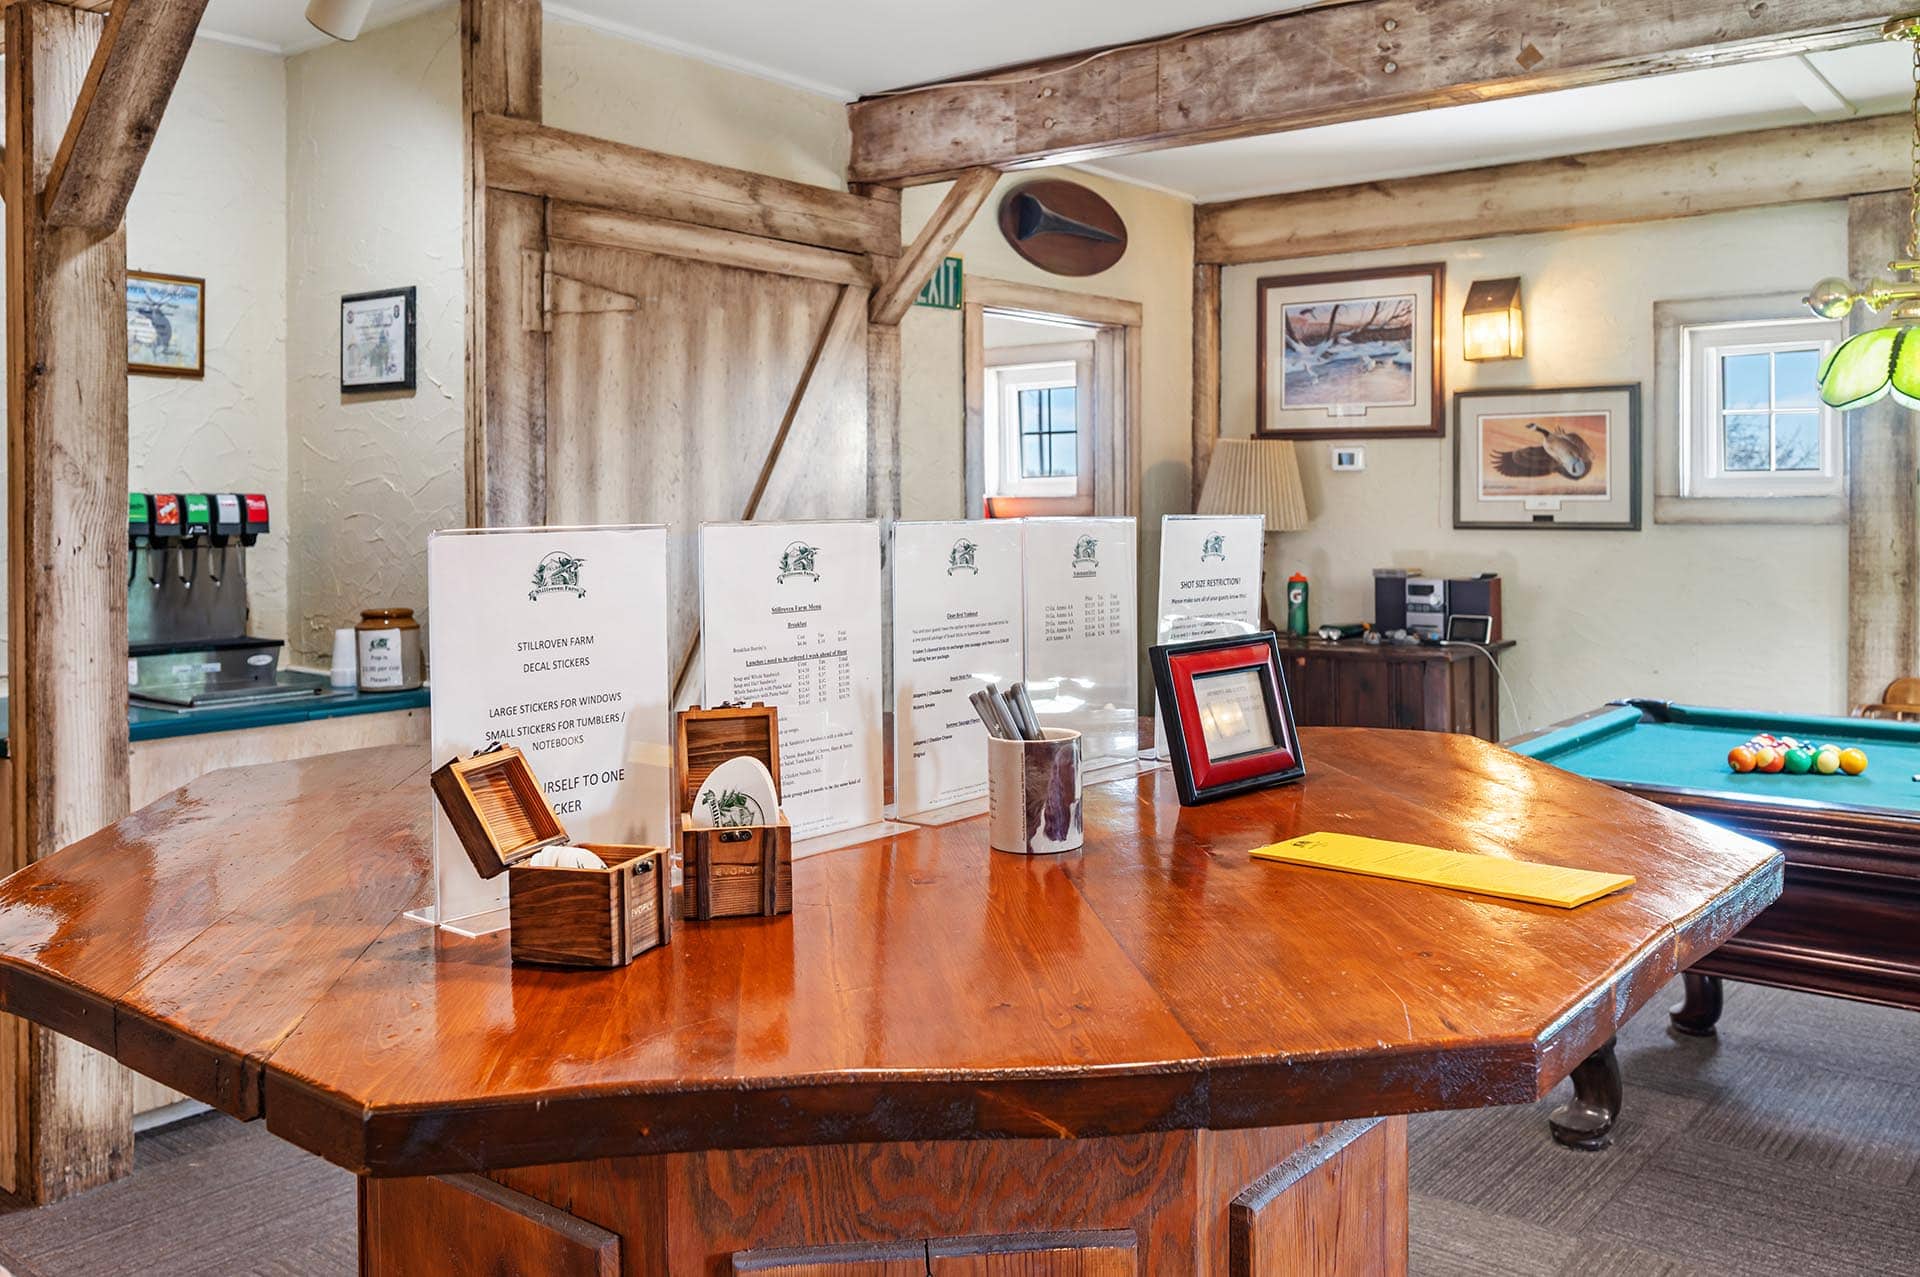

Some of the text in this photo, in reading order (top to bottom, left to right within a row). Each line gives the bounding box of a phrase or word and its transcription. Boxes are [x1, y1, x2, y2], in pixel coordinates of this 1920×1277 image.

[517, 635, 594, 652] STILLROVEN FARM
[523, 656, 590, 674] DECAL STICKERS
[489, 692, 622, 718] LARGE STICKERS FOR WINDOWS
[486, 712, 626, 741] SMALL STICKERS FOR TUMBLERS /
[532, 734, 584, 751] NOTEBOOKS
[582, 772, 599, 787] TO
[601, 768, 625, 784] ONE
